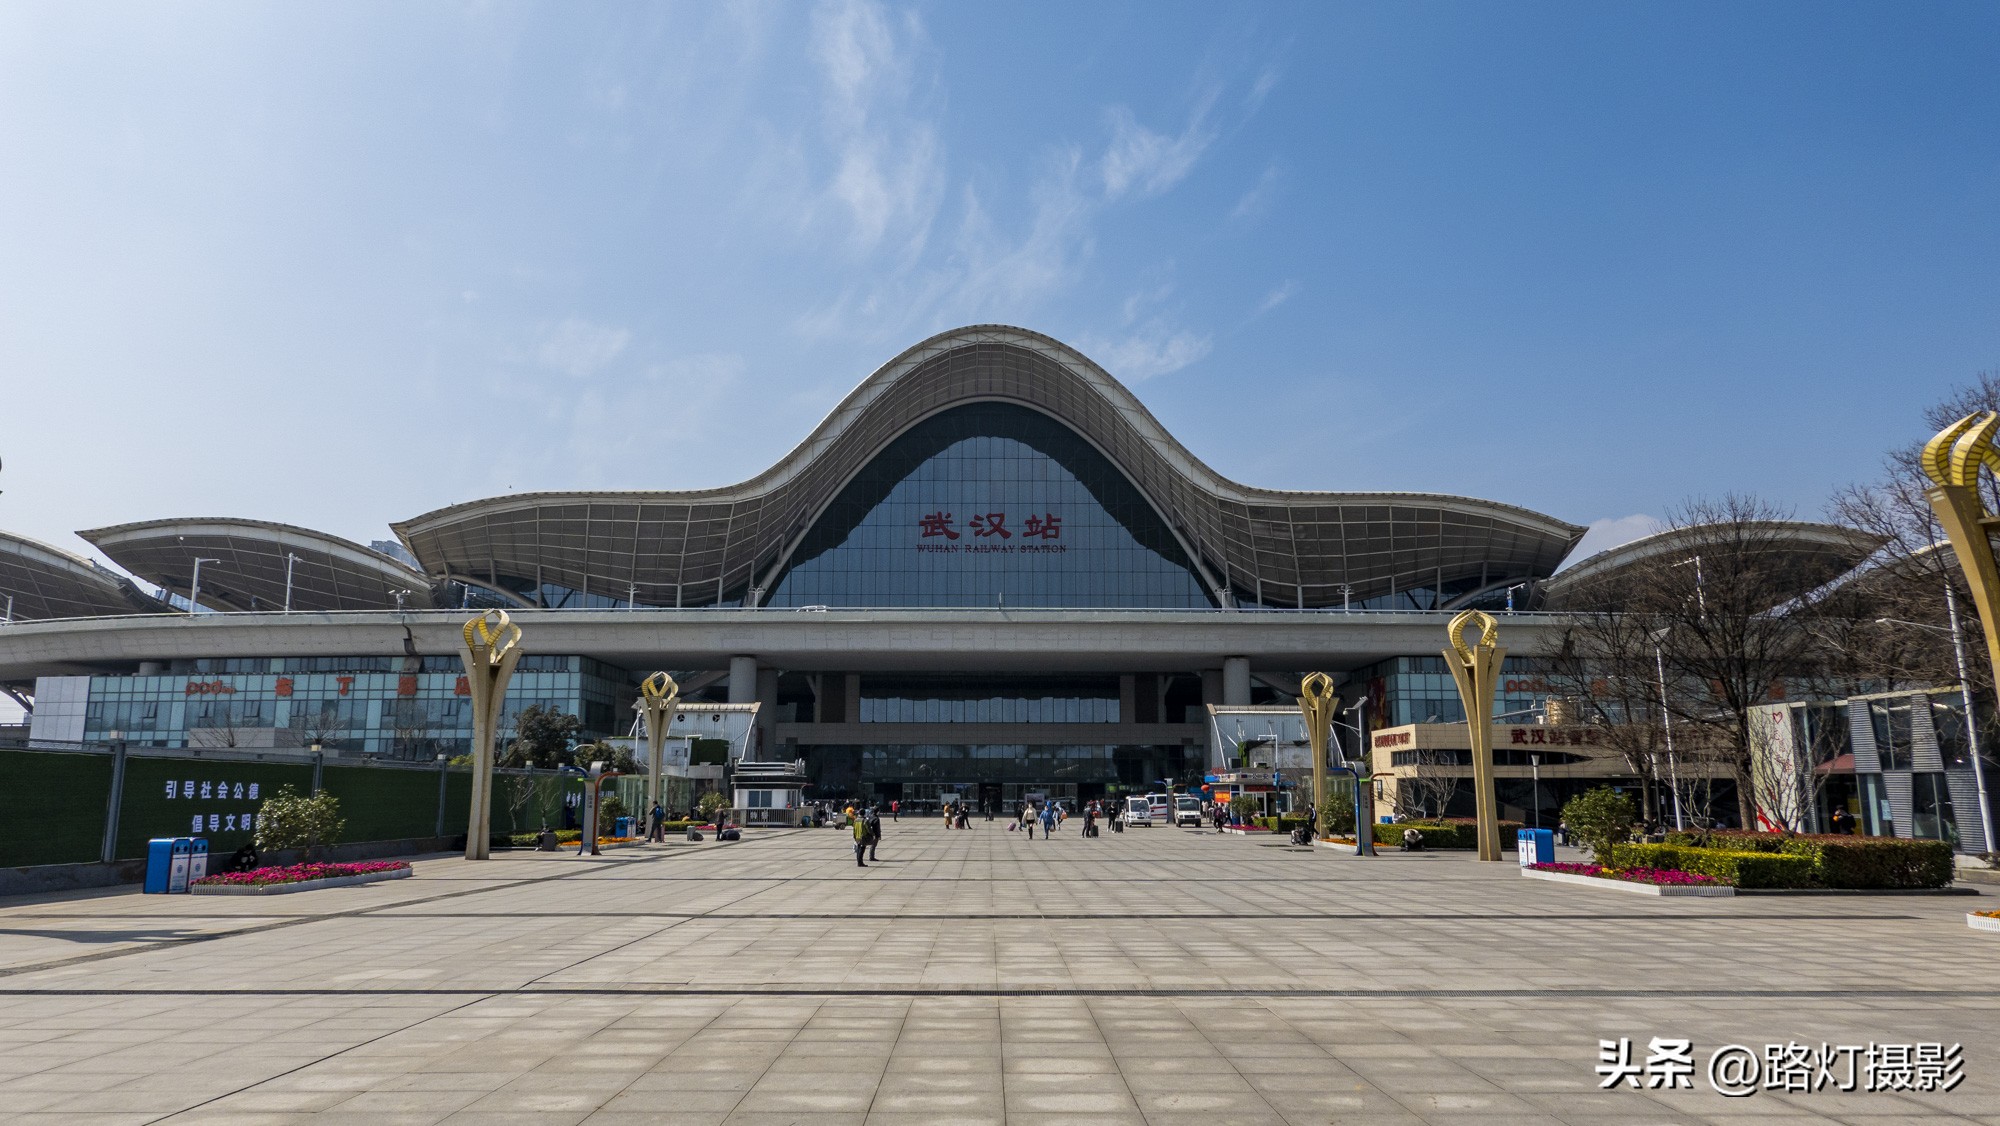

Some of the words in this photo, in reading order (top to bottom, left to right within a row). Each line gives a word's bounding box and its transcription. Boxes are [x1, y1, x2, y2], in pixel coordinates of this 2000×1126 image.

[919, 511, 1062, 540] 武汉站
[916, 544, 959, 553] WUHAN
[964, 544, 1016, 553] RAILWAY
[1020, 544, 1067, 553] STATION
[165, 780, 260, 800] 引导社会公德
